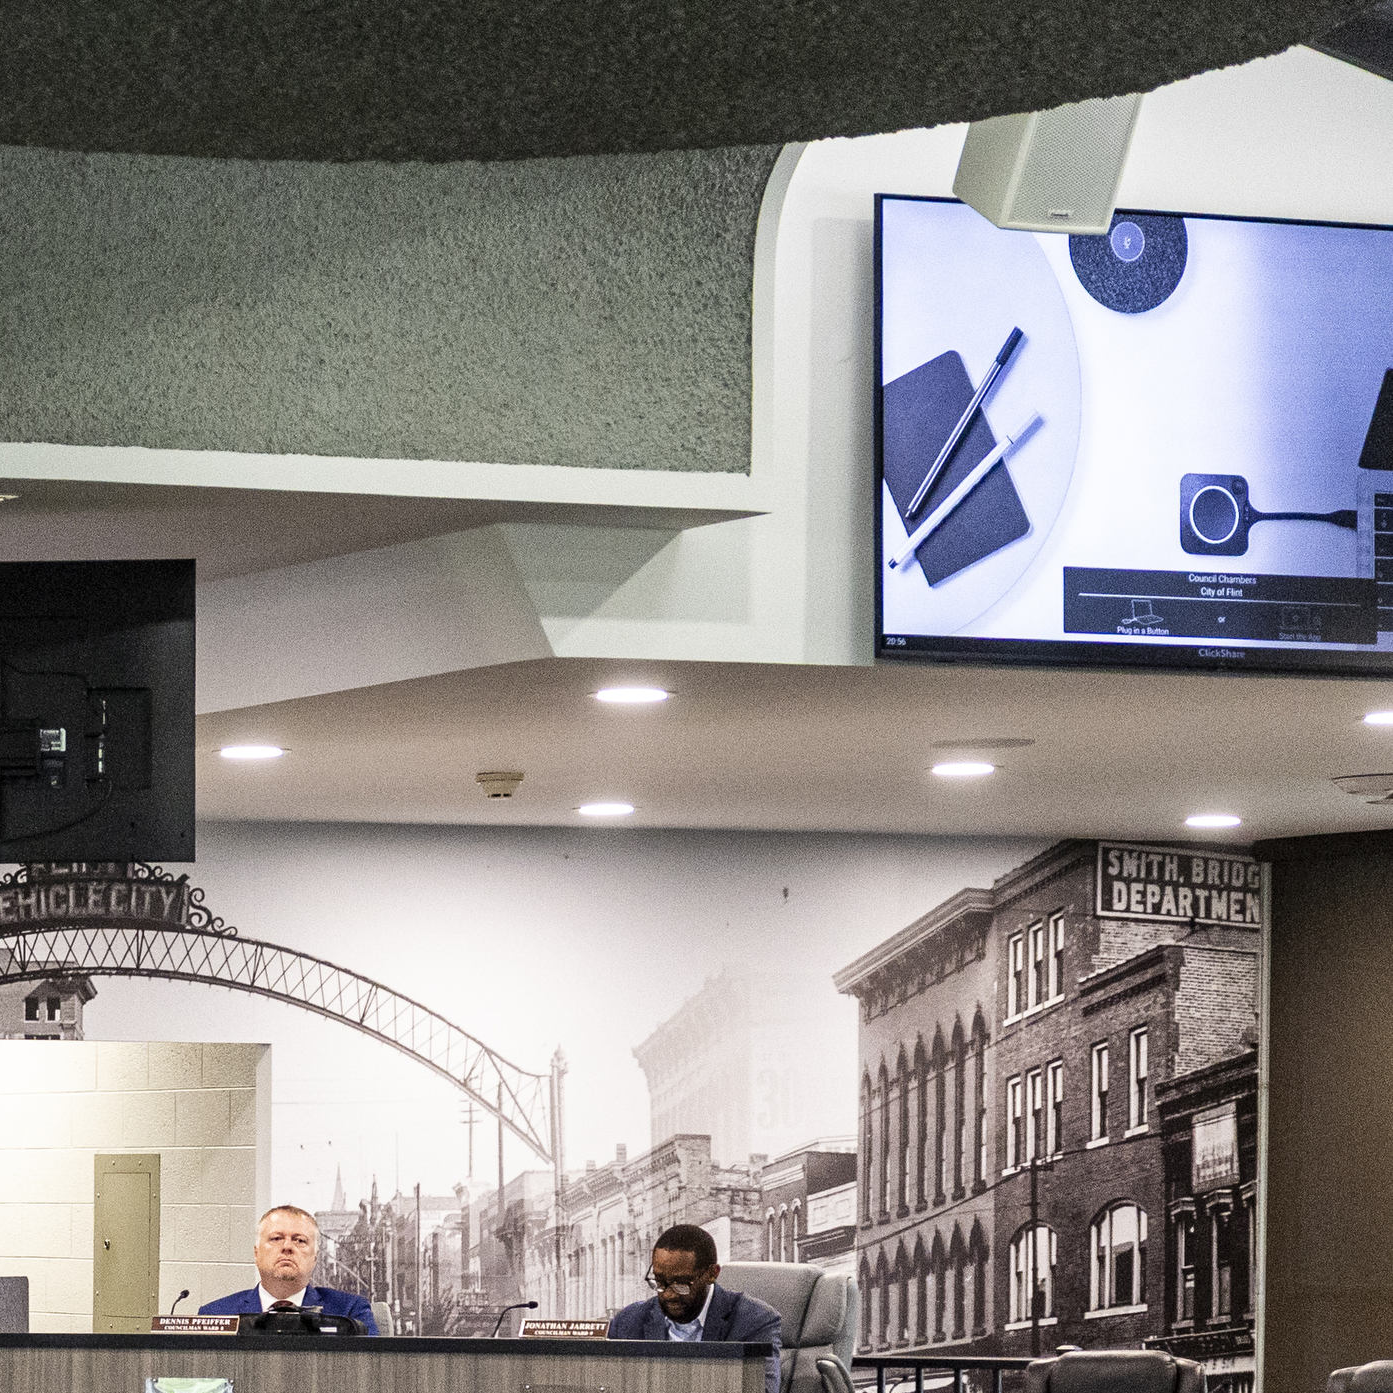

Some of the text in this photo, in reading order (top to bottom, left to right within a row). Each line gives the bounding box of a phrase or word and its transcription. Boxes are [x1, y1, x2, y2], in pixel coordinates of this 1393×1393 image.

[1188, 573, 1257, 586] Council Chambers
[1200, 586, 1243, 598] City of Flint
[1117, 625, 1132, 636] Plug
[1132, 626, 1140, 635] in
[1147, 627, 1170, 636] Button
[1198, 648, 1246, 659] ClickShare
[110, 883, 178, 920] CITY
[1112, 880, 1261, 923] DEPARTMEN
[191, 1318, 231, 1326] PFEIFFER
[525, 1322, 607, 1331] JONATHAN JARRETT
